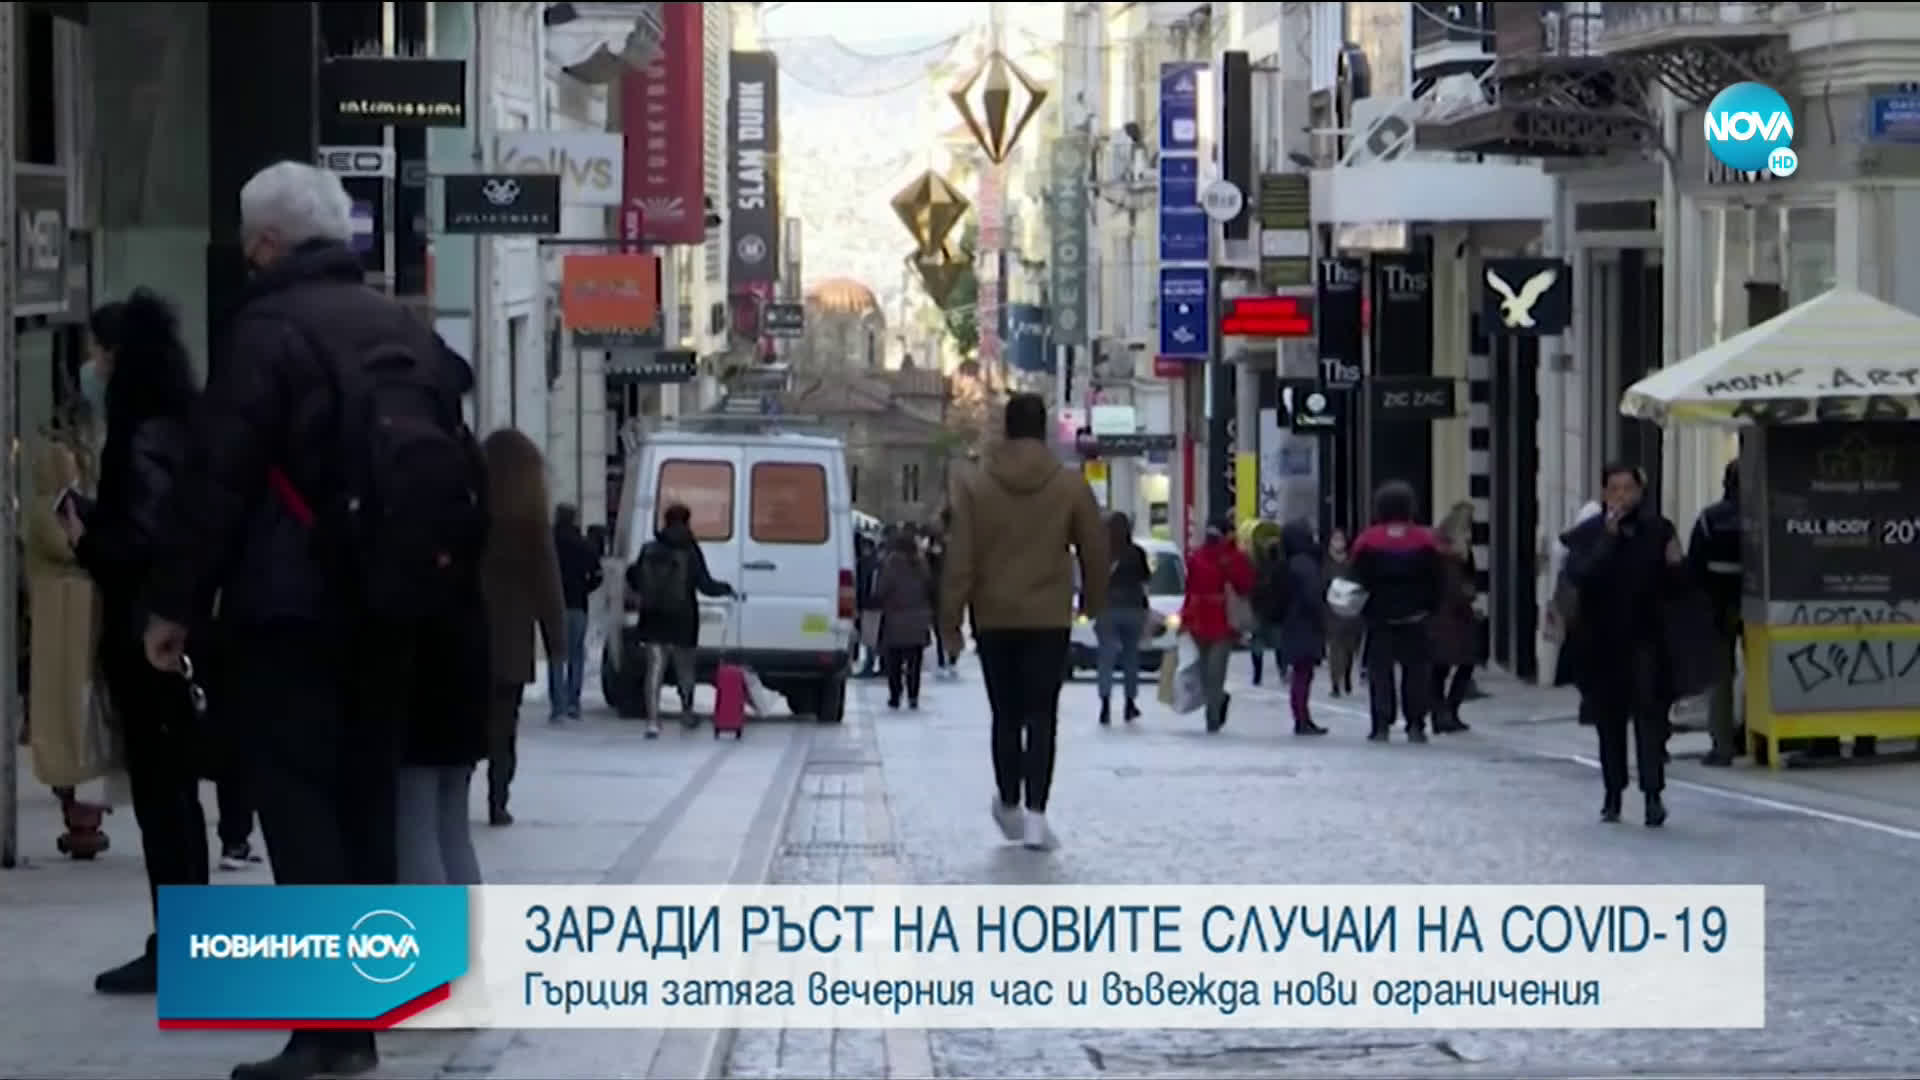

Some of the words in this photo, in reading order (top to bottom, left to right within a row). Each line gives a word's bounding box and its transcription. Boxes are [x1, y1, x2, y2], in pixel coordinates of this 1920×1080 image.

[339, 99, 462, 117] intimissimi
[737, 81, 765, 142] DUNK
[737, 150, 765, 210] SLAM
[1322, 260, 1360, 283] Ths
[1384, 265, 1427, 292] Ths
[1322, 358, 1361, 382] Ths
[1786, 519, 1823, 535] FULL
[1826, 519, 1873, 535] BODY
